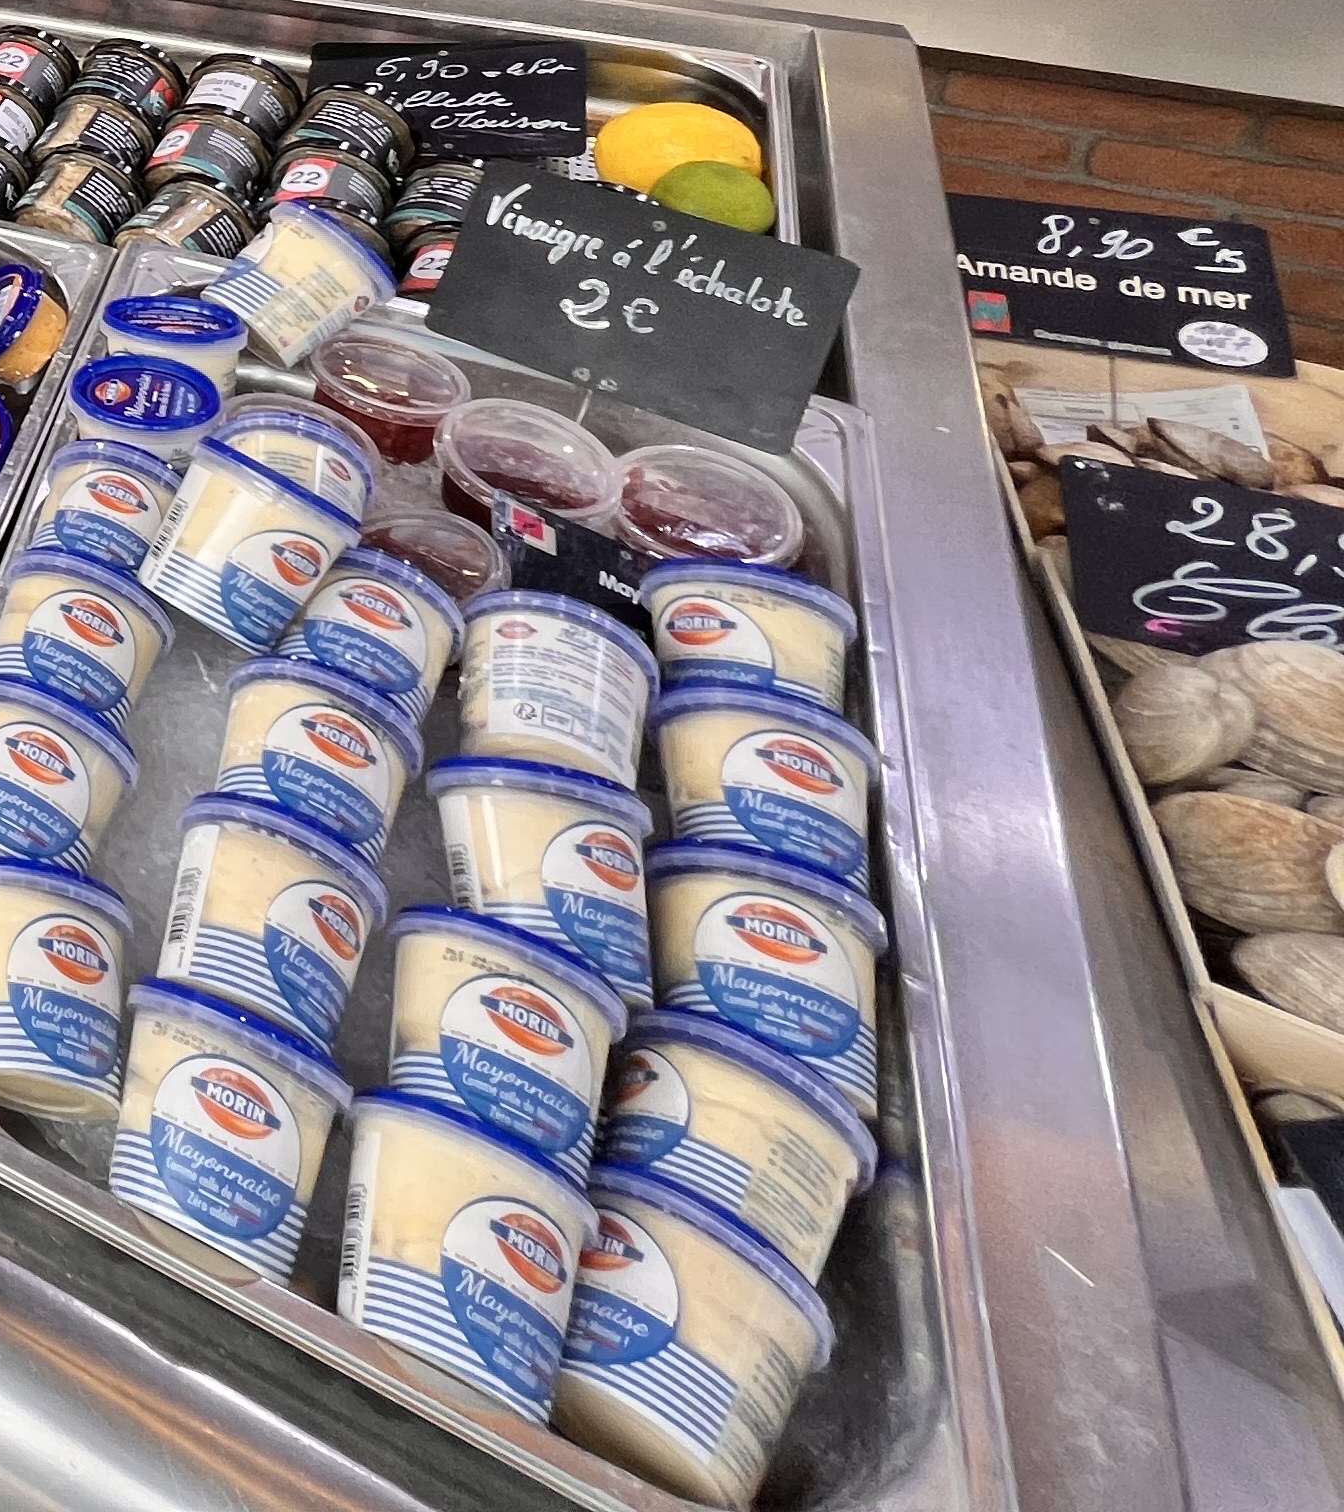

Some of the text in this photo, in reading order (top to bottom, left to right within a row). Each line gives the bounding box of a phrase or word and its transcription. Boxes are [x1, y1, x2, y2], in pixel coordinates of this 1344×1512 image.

[374, 57, 469, 82] 6,90
[364, 82, 514, 112] llette
[286, 170, 323, 186] 22
[1036, 214, 1155, 261] 8,90
[643, 235, 809, 328] l'échalote
[957, 252, 1252, 311] Amande de mer
[96, 477, 142, 508] MORIN
[1165, 496, 1344, 578] 28,
[70, 606, 116, 637] MORIN
[352, 591, 402, 622] MORIN
[674, 616, 721, 631] MORIN
[16, 739, 66, 775] MORIN
[314, 721, 368, 757] MORIN
[773, 748, 832, 781] MORIN
[271, 753, 378, 823] Mayonnaise
[743, 915, 811, 948] MORIN
[51, 939, 101, 970] MORIN
[712, 962, 847, 1023] Mayonnaise
[498, 1000, 560, 1042] MORIN
[451, 1041, 580, 1118] Mayonnaise
[206, 1079, 267, 1124] MORIN
[159, 1123, 282, 1207] Mayonnaise
